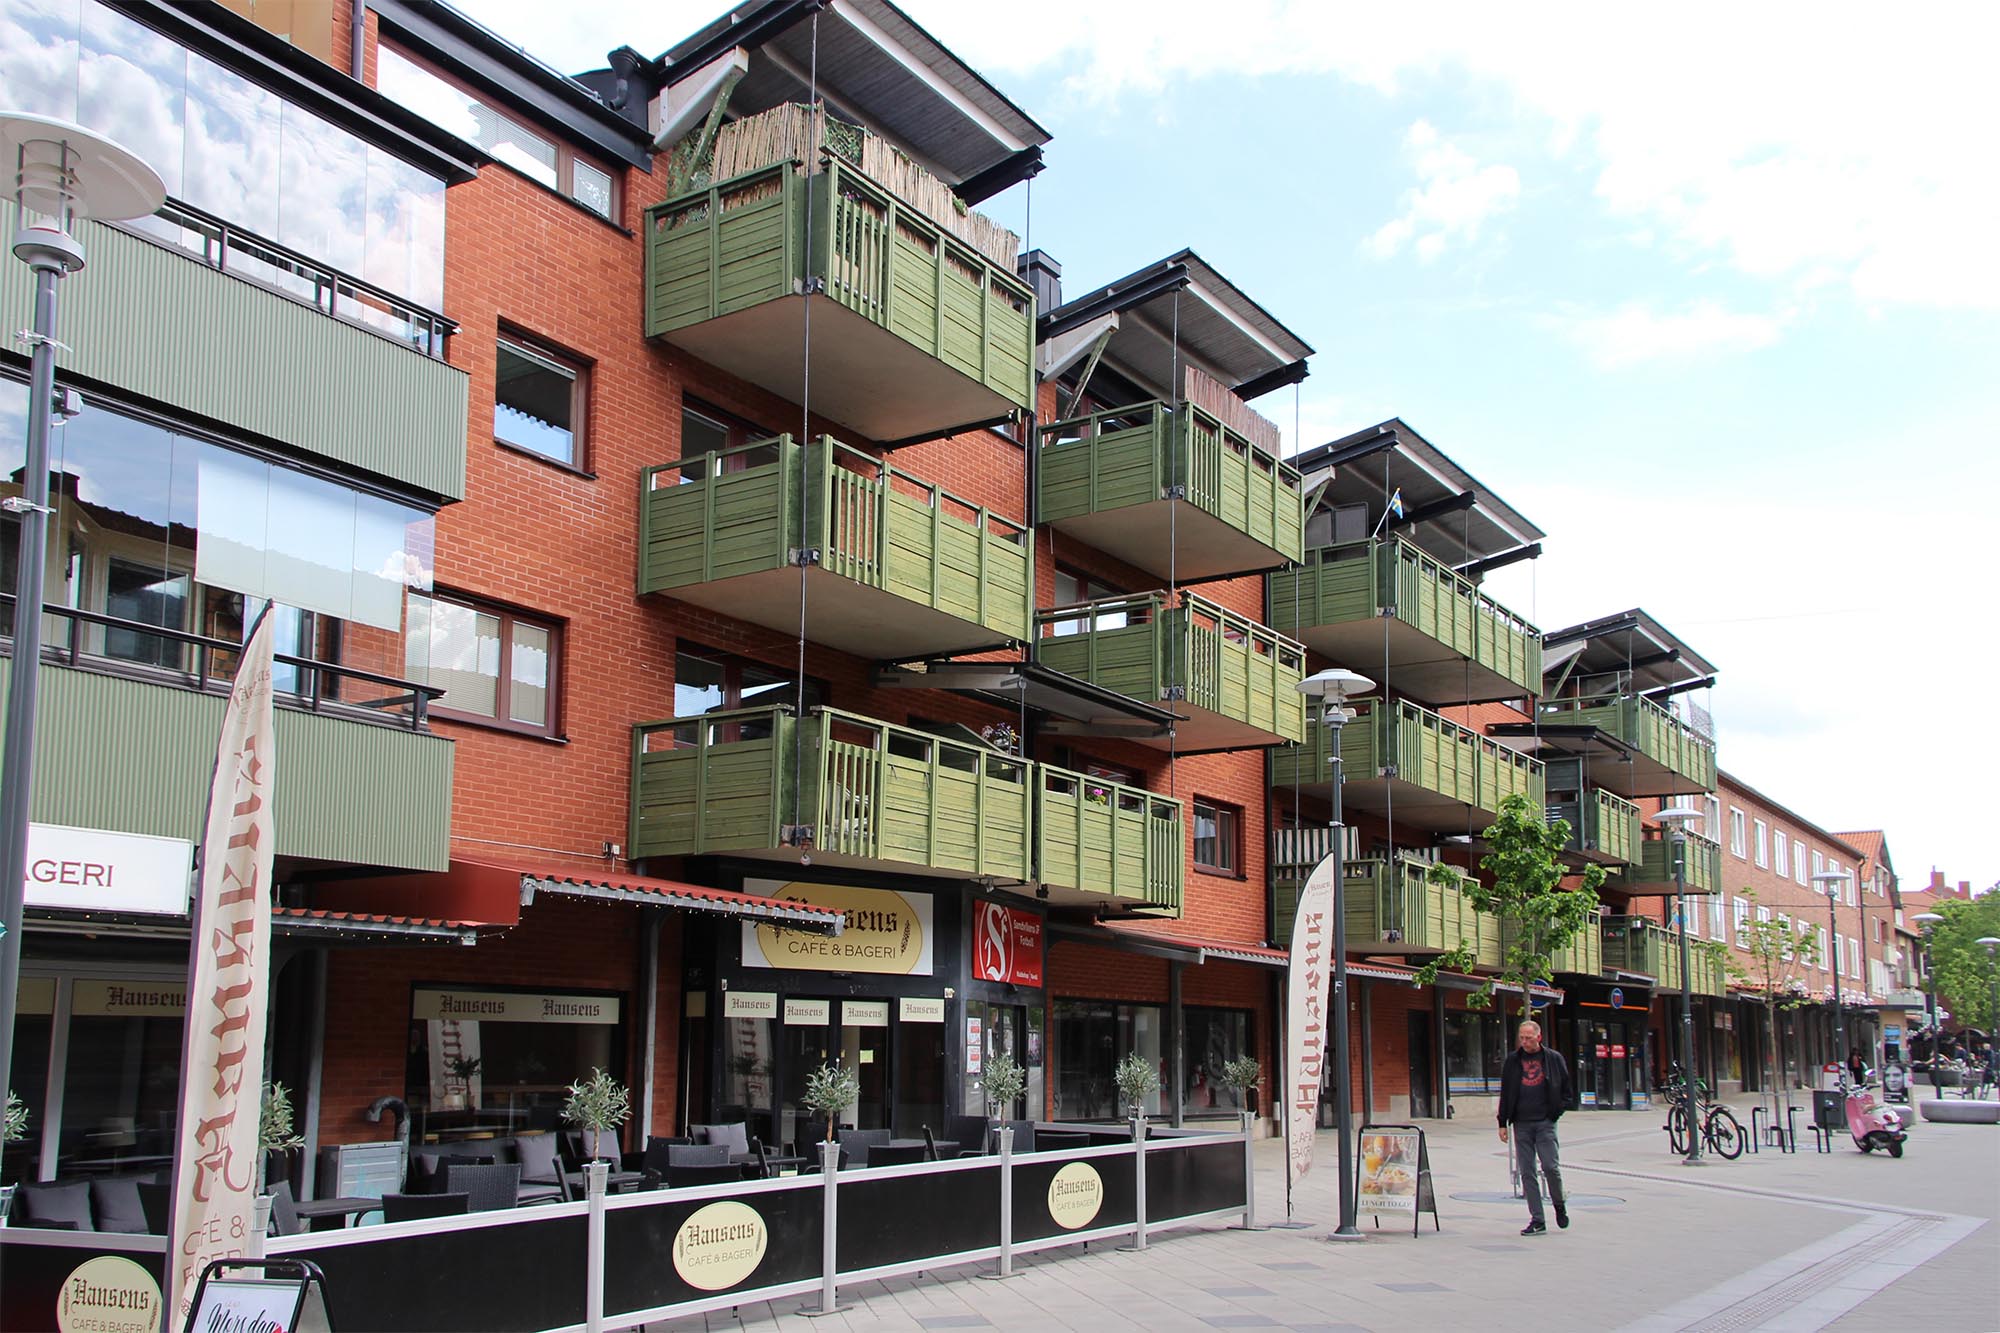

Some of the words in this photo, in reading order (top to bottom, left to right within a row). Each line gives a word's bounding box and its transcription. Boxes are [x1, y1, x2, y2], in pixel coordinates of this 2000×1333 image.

[788, 941, 828, 955] CAFÉ
[831, 944, 842, 956] &
[844, 945, 896, 959] BAGERI
[440, 995, 505, 1017] Hansens
[542, 998, 601, 1018] Hansens
[732, 998, 771, 1011] Hansens
[786, 1005, 824, 1017] Hansens
[847, 1007, 883, 1019] Hansens
[905, 1004, 939, 1016] Hansens
[1055, 1179, 1096, 1197] Hansens
[230, 1215, 245, 1239] &
[686, 1222, 755, 1253] Hansens
[714, 1255, 720, 1264] &
[721, 1248, 754, 1263] BAGERI
[71, 1277, 149, 1311] Hansens
[72, 1317, 99, 1331] CAFÉ
[99, 1321, 107, 1332] &
